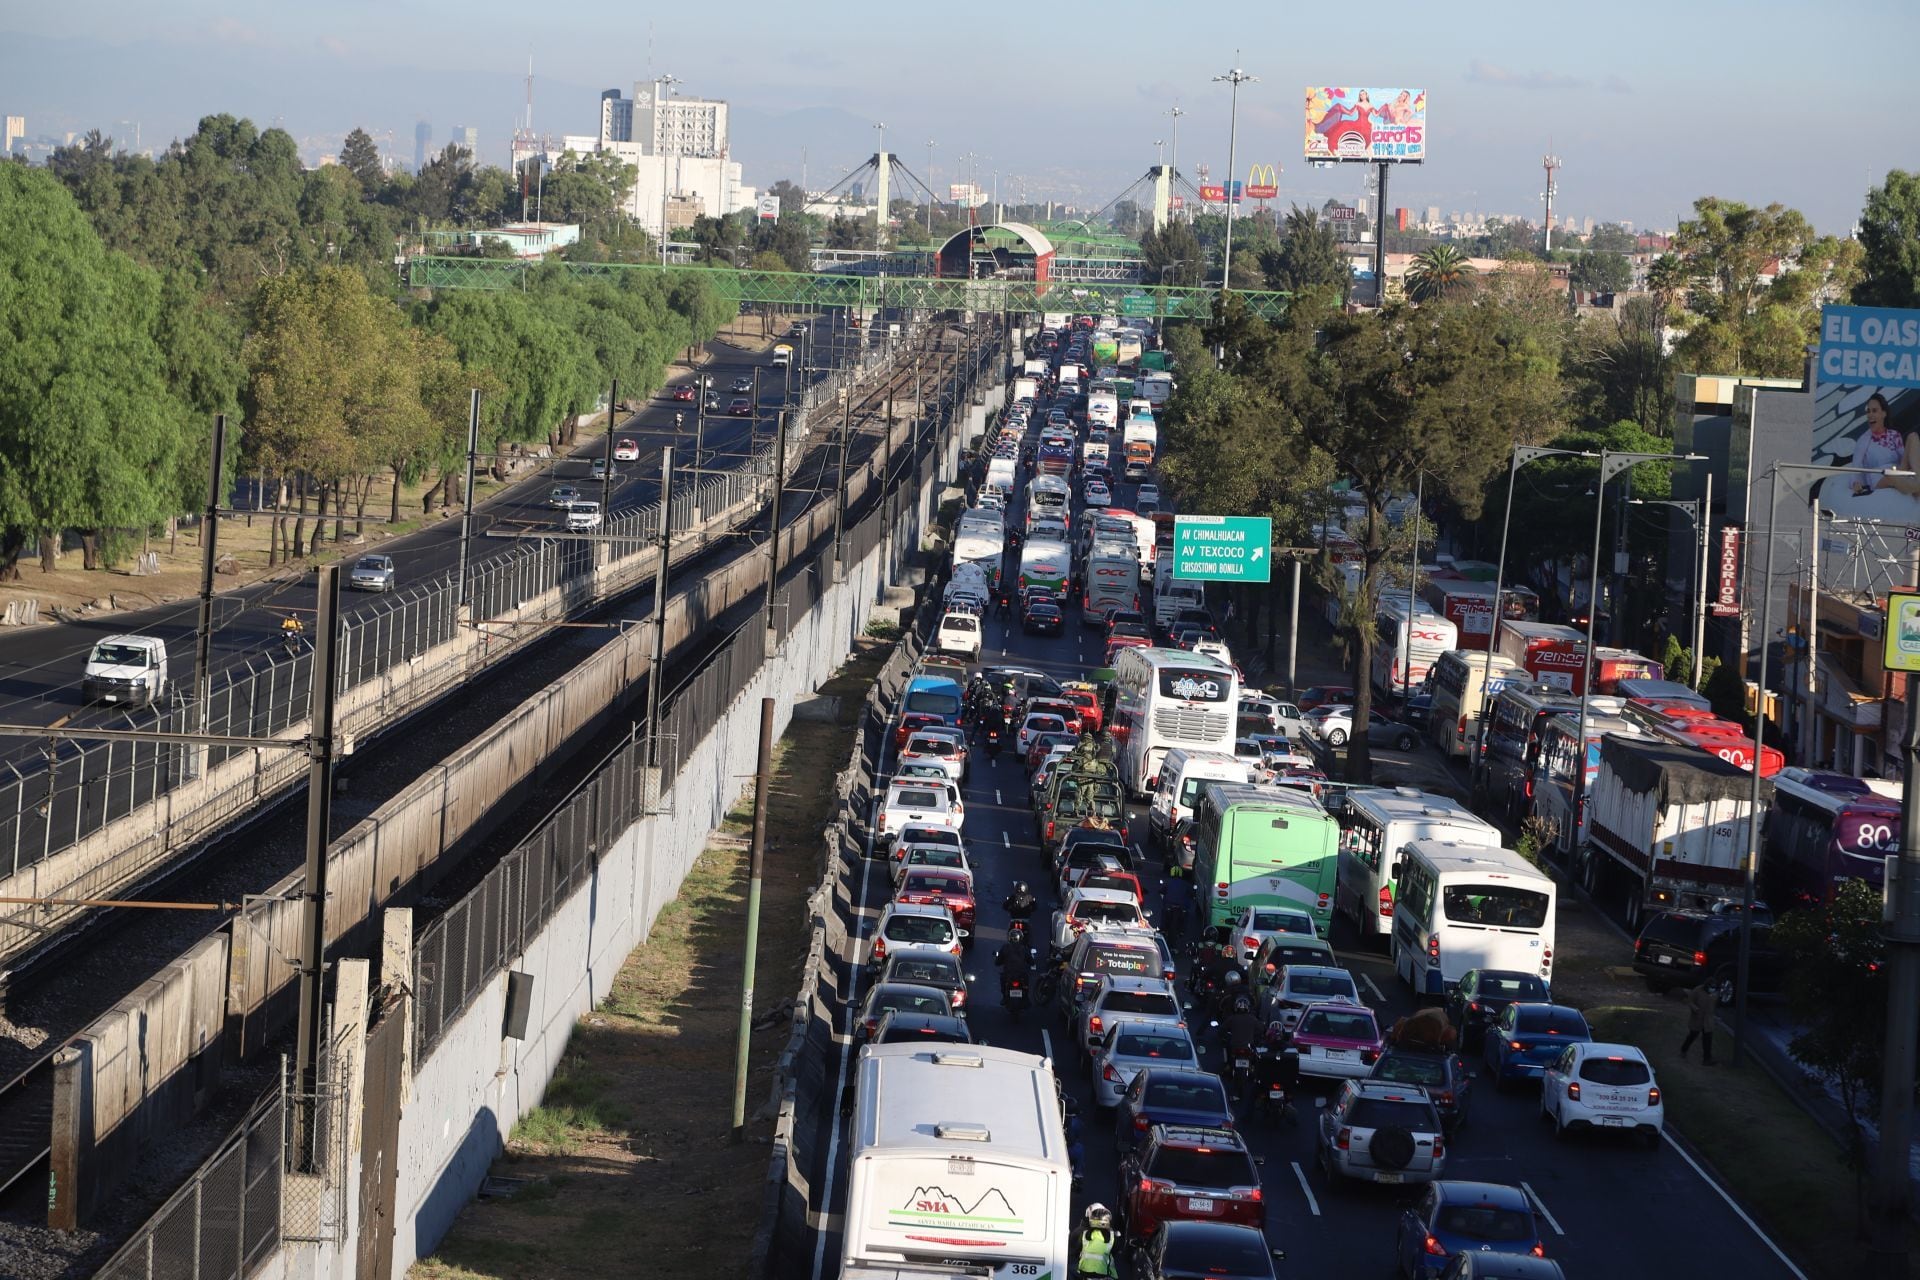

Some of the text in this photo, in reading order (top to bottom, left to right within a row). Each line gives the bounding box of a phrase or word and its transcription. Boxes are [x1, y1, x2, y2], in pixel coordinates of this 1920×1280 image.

[1331, 208, 1354, 218] HOTEL
[1825, 315, 1920, 347] EL OAS
[1823, 349, 1920, 380] CERCA
[1182, 529, 1245, 541] AV CHIMALHUACAN
[1182, 545, 1245, 558] AV TEXCOCO
[1181, 562, 1244, 574] CRISOSTOMO BONILLA
[1721, 527, 1738, 604] VELATORIOS
[1857, 824, 1891, 850] 80
[1108, 960, 1146, 972] Totalplay
[916, 1200, 950, 1213] SMA
[1012, 1265, 1037, 1275] 368
